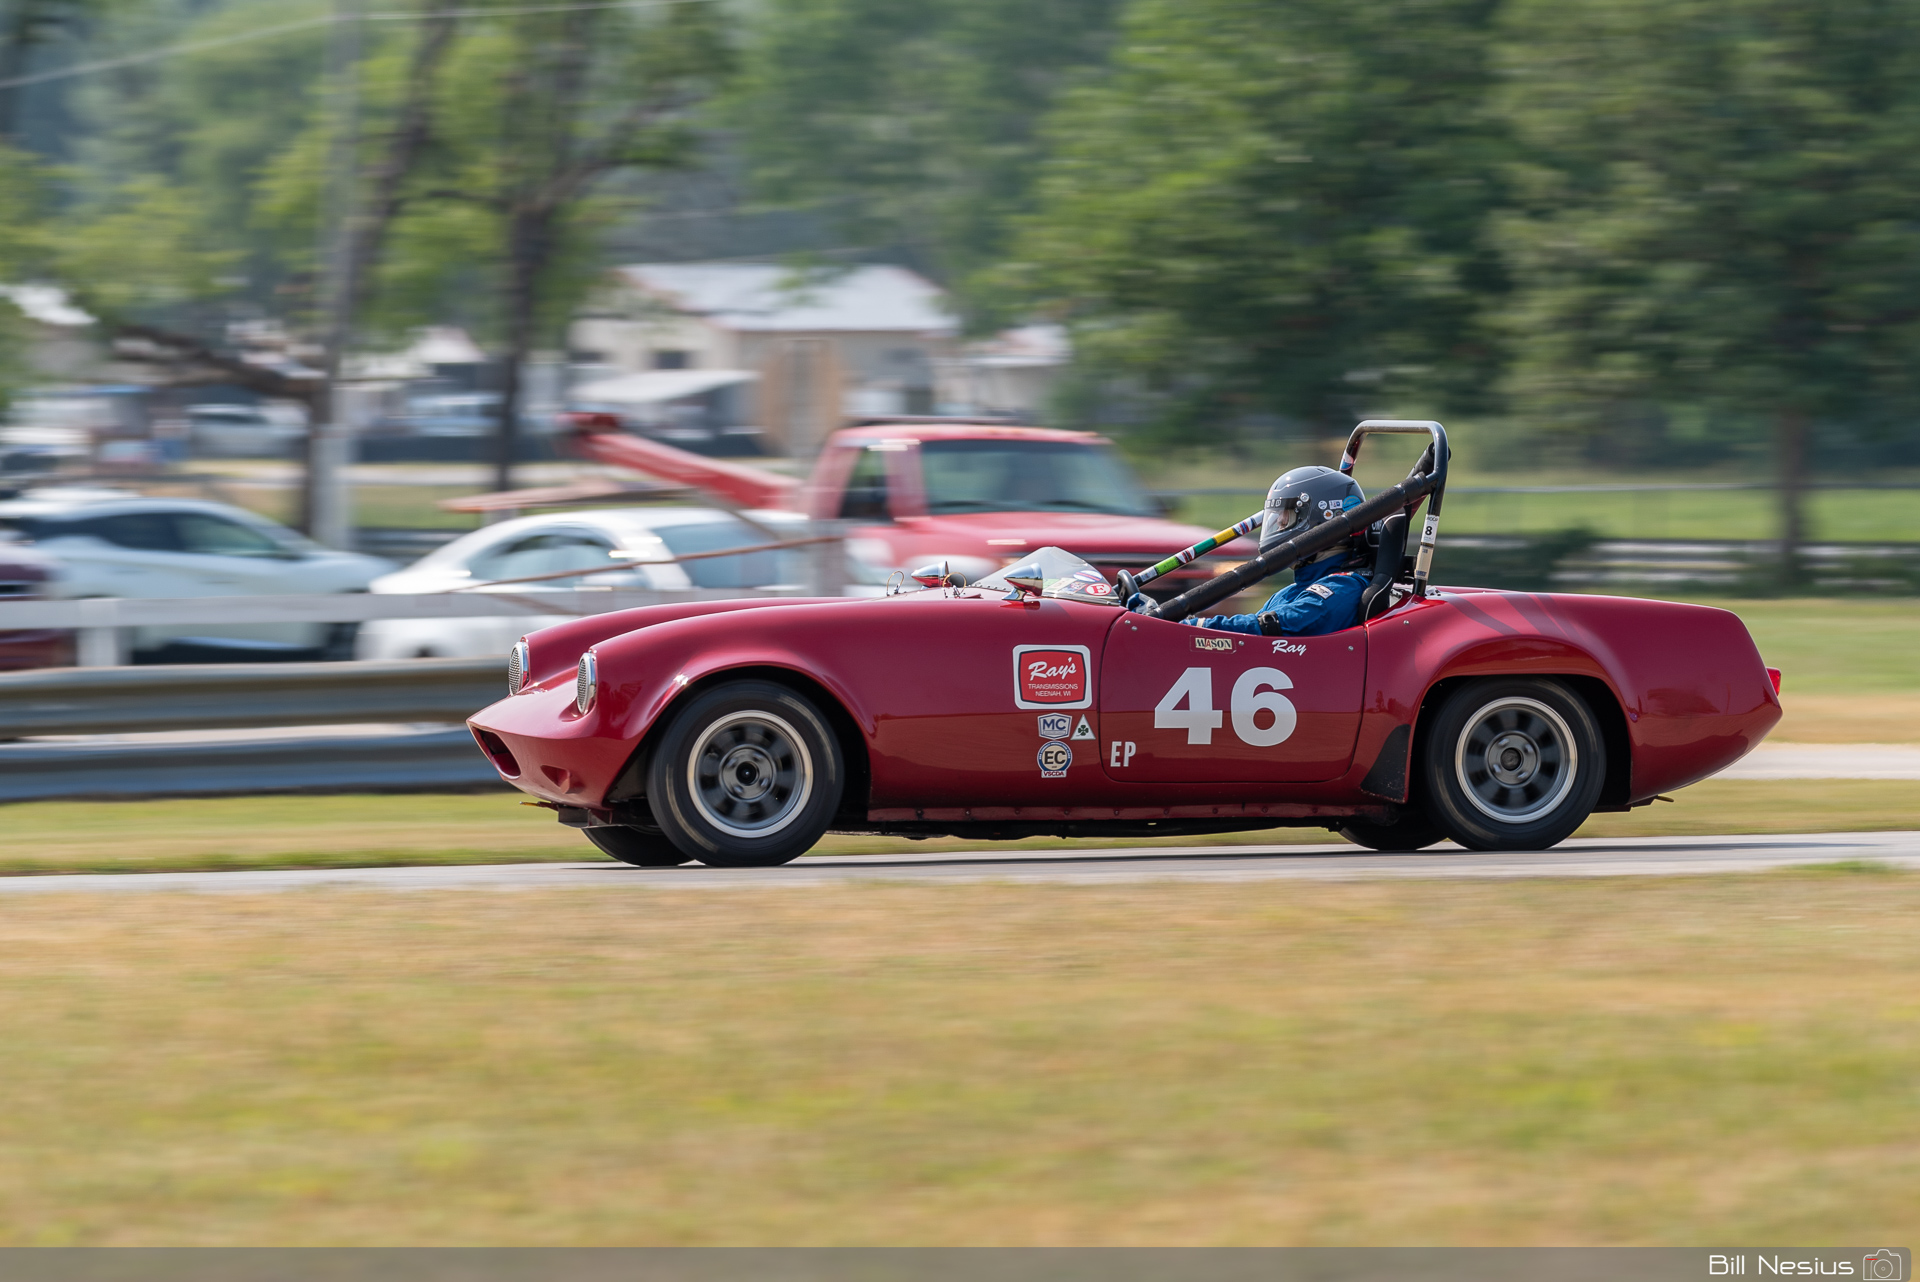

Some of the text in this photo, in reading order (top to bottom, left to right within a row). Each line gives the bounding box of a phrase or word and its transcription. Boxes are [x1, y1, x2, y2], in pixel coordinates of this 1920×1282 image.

[1425, 525, 1433, 536] 8
[1091, 584, 1107, 595] E
[1271, 639, 1307, 656] Ray
[1028, 656, 1077, 681] Ray's
[1154, 666, 1298, 747] 46
[1042, 718, 1067, 730] MC
[1044, 750, 1066, 765] EC
[1110, 740, 1137, 768] EP
